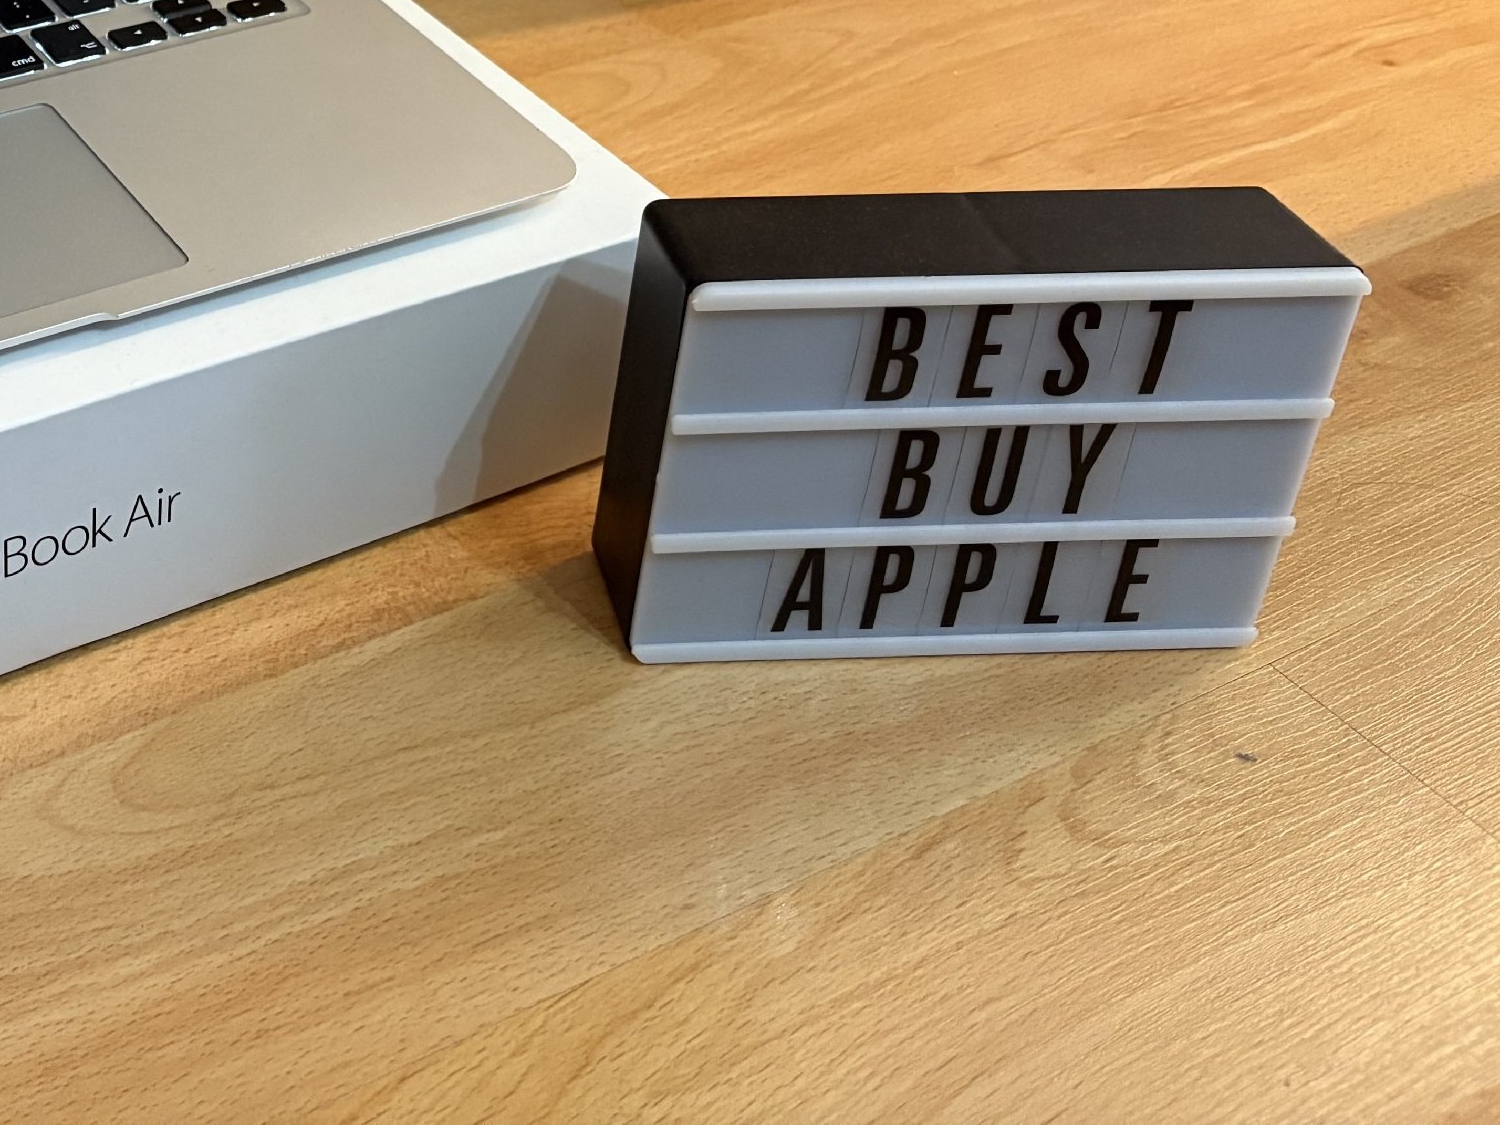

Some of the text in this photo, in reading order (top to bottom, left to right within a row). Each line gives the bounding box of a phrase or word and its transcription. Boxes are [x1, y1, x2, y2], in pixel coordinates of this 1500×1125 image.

[12, 56, 35, 67] cmd
[865, 300, 1193, 401] BEST
[123, 488, 181, 537] Air
[880, 424, 1116, 518] BUY
[770, 538, 1160, 632] APPLE
